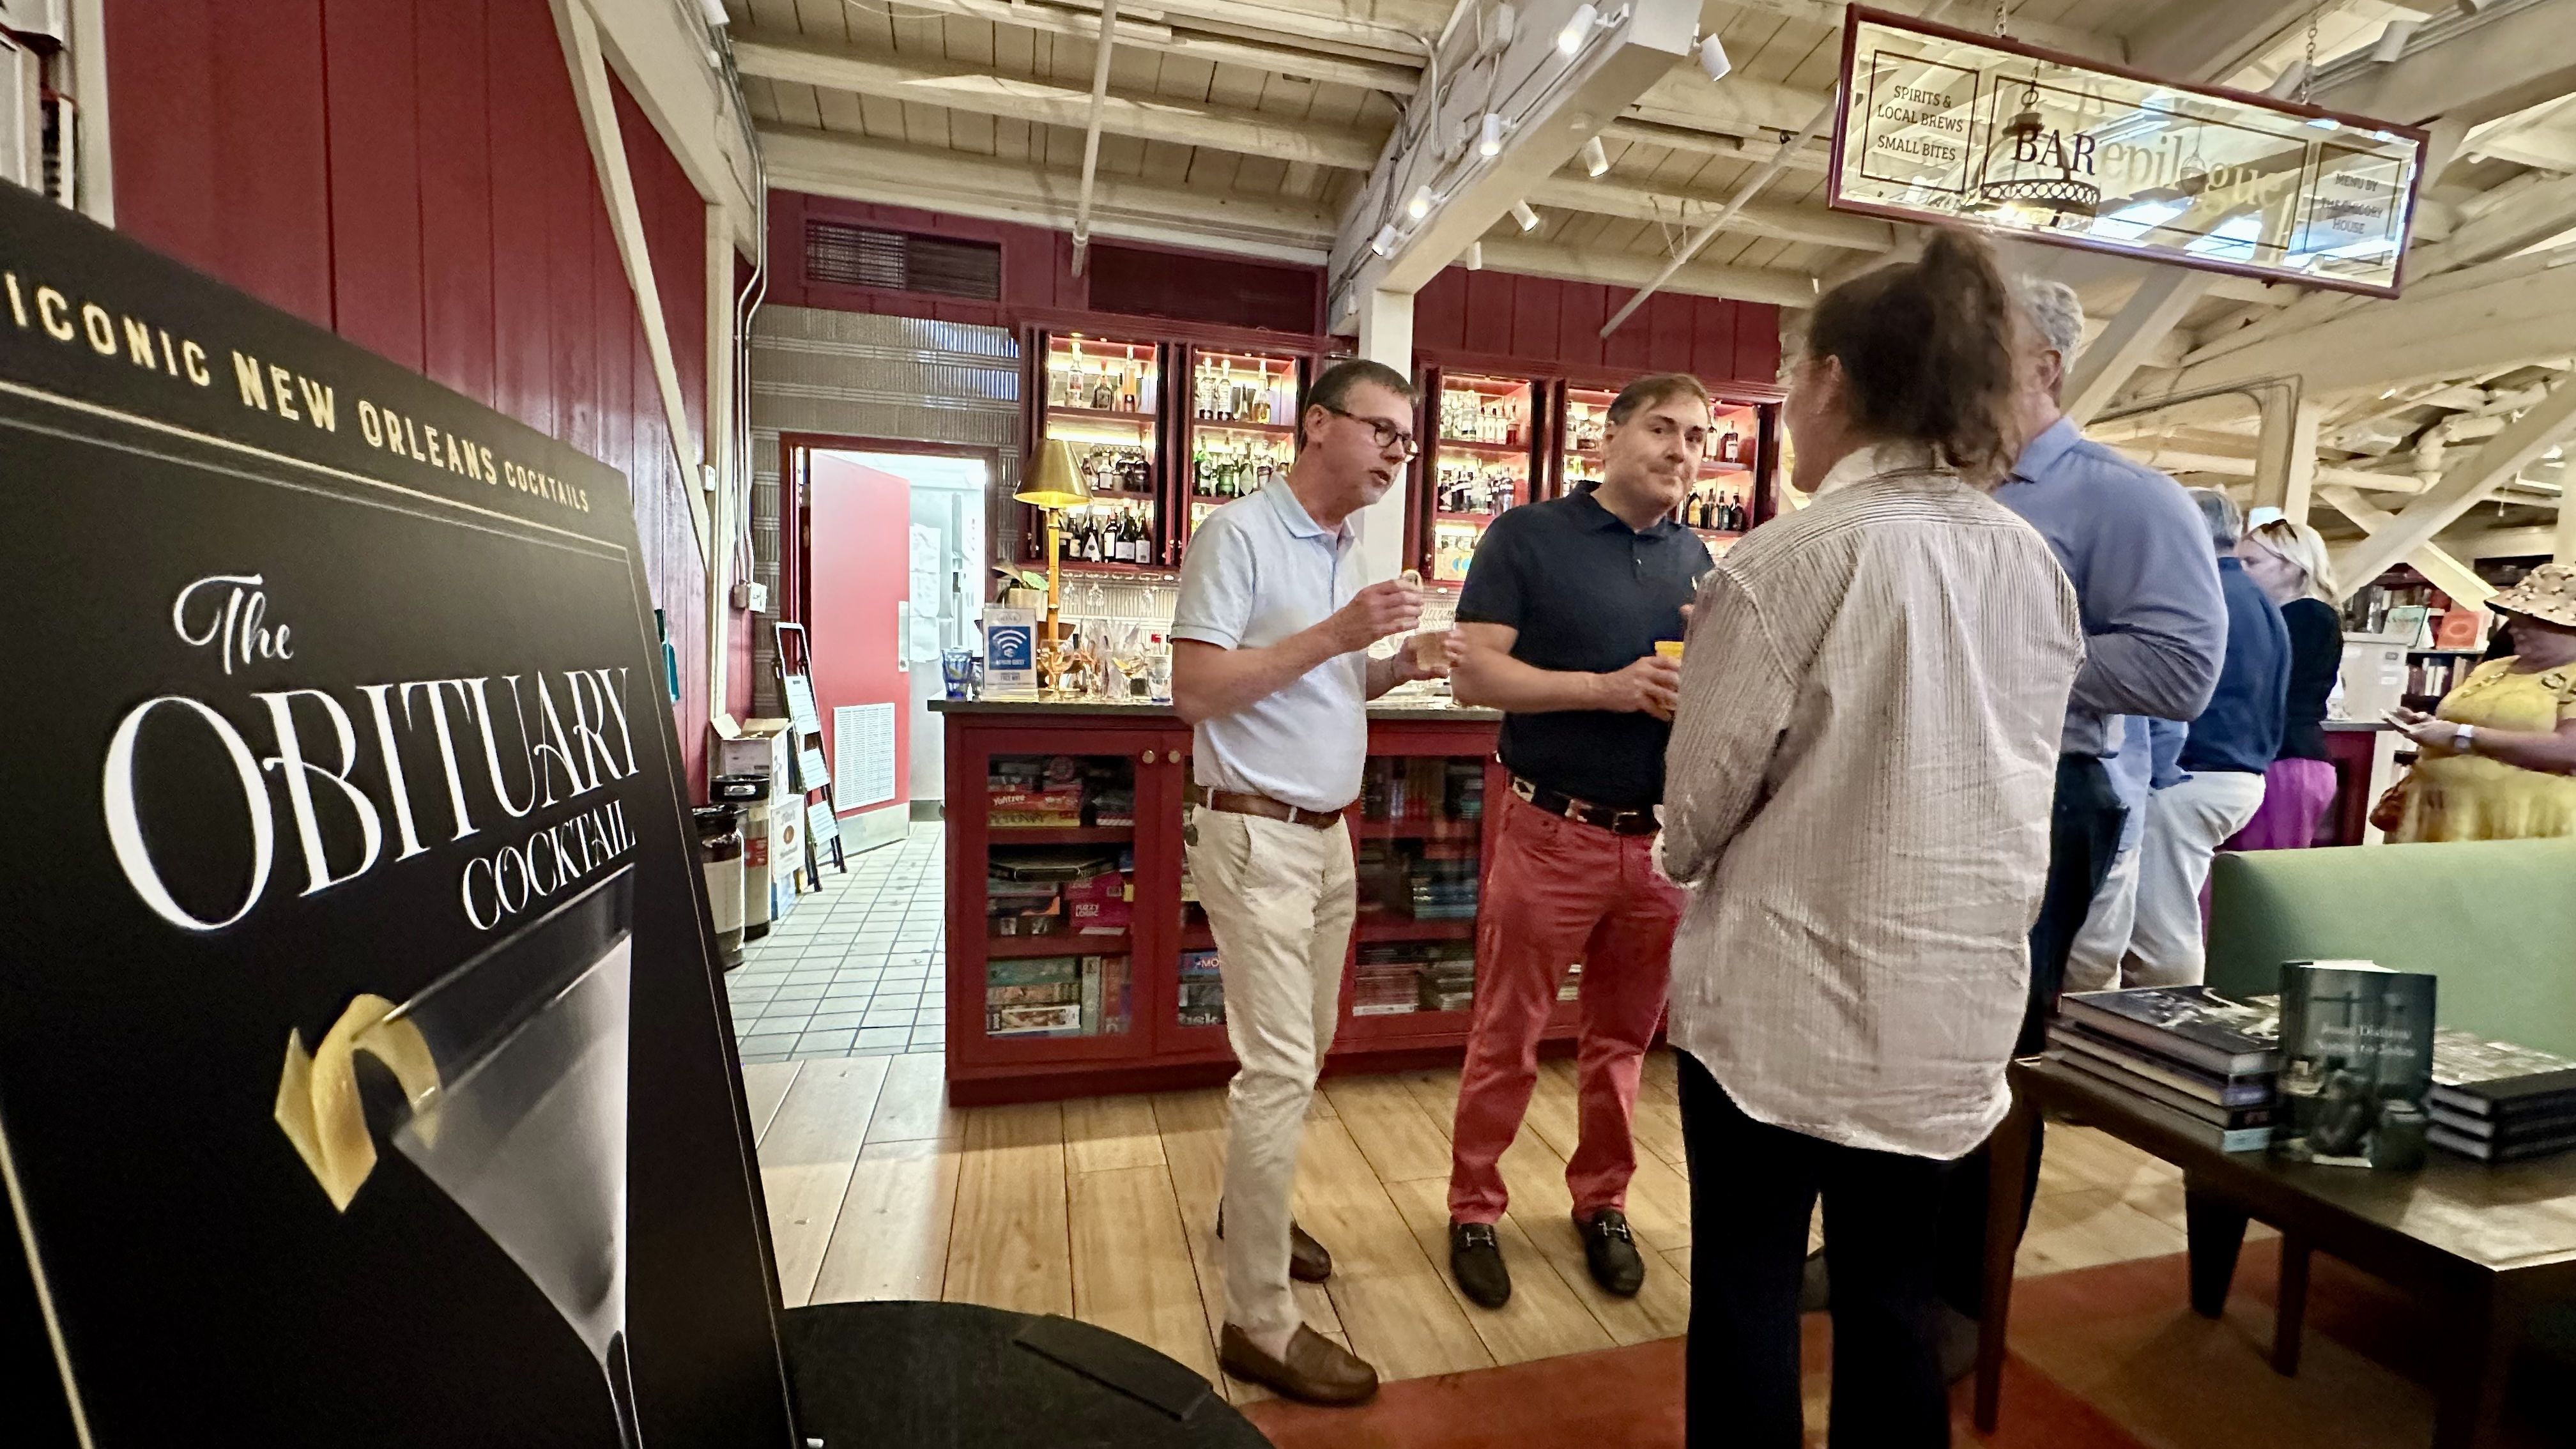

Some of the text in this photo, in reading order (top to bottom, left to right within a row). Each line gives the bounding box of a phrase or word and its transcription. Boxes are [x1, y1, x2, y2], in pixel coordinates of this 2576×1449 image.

[1894, 85, 1952, 109] SPIRITS &
[1877, 104, 1963, 132] LOCAL BREWS
[1877, 135, 1956, 160] SMALL BITES
[2011, 129, 2096, 176] BAR
[2335, 174, 2379, 192] MENU BY
[2333, 218, 2365, 234] HOUSE
[4, 271, 589, 512] ICONIC NEW ORLEANS COCKTAILS
[173, 573, 295, 675] The
[103, 666, 640, 932] OBITUARY
[461, 799, 636, 931] COCKTAIL
